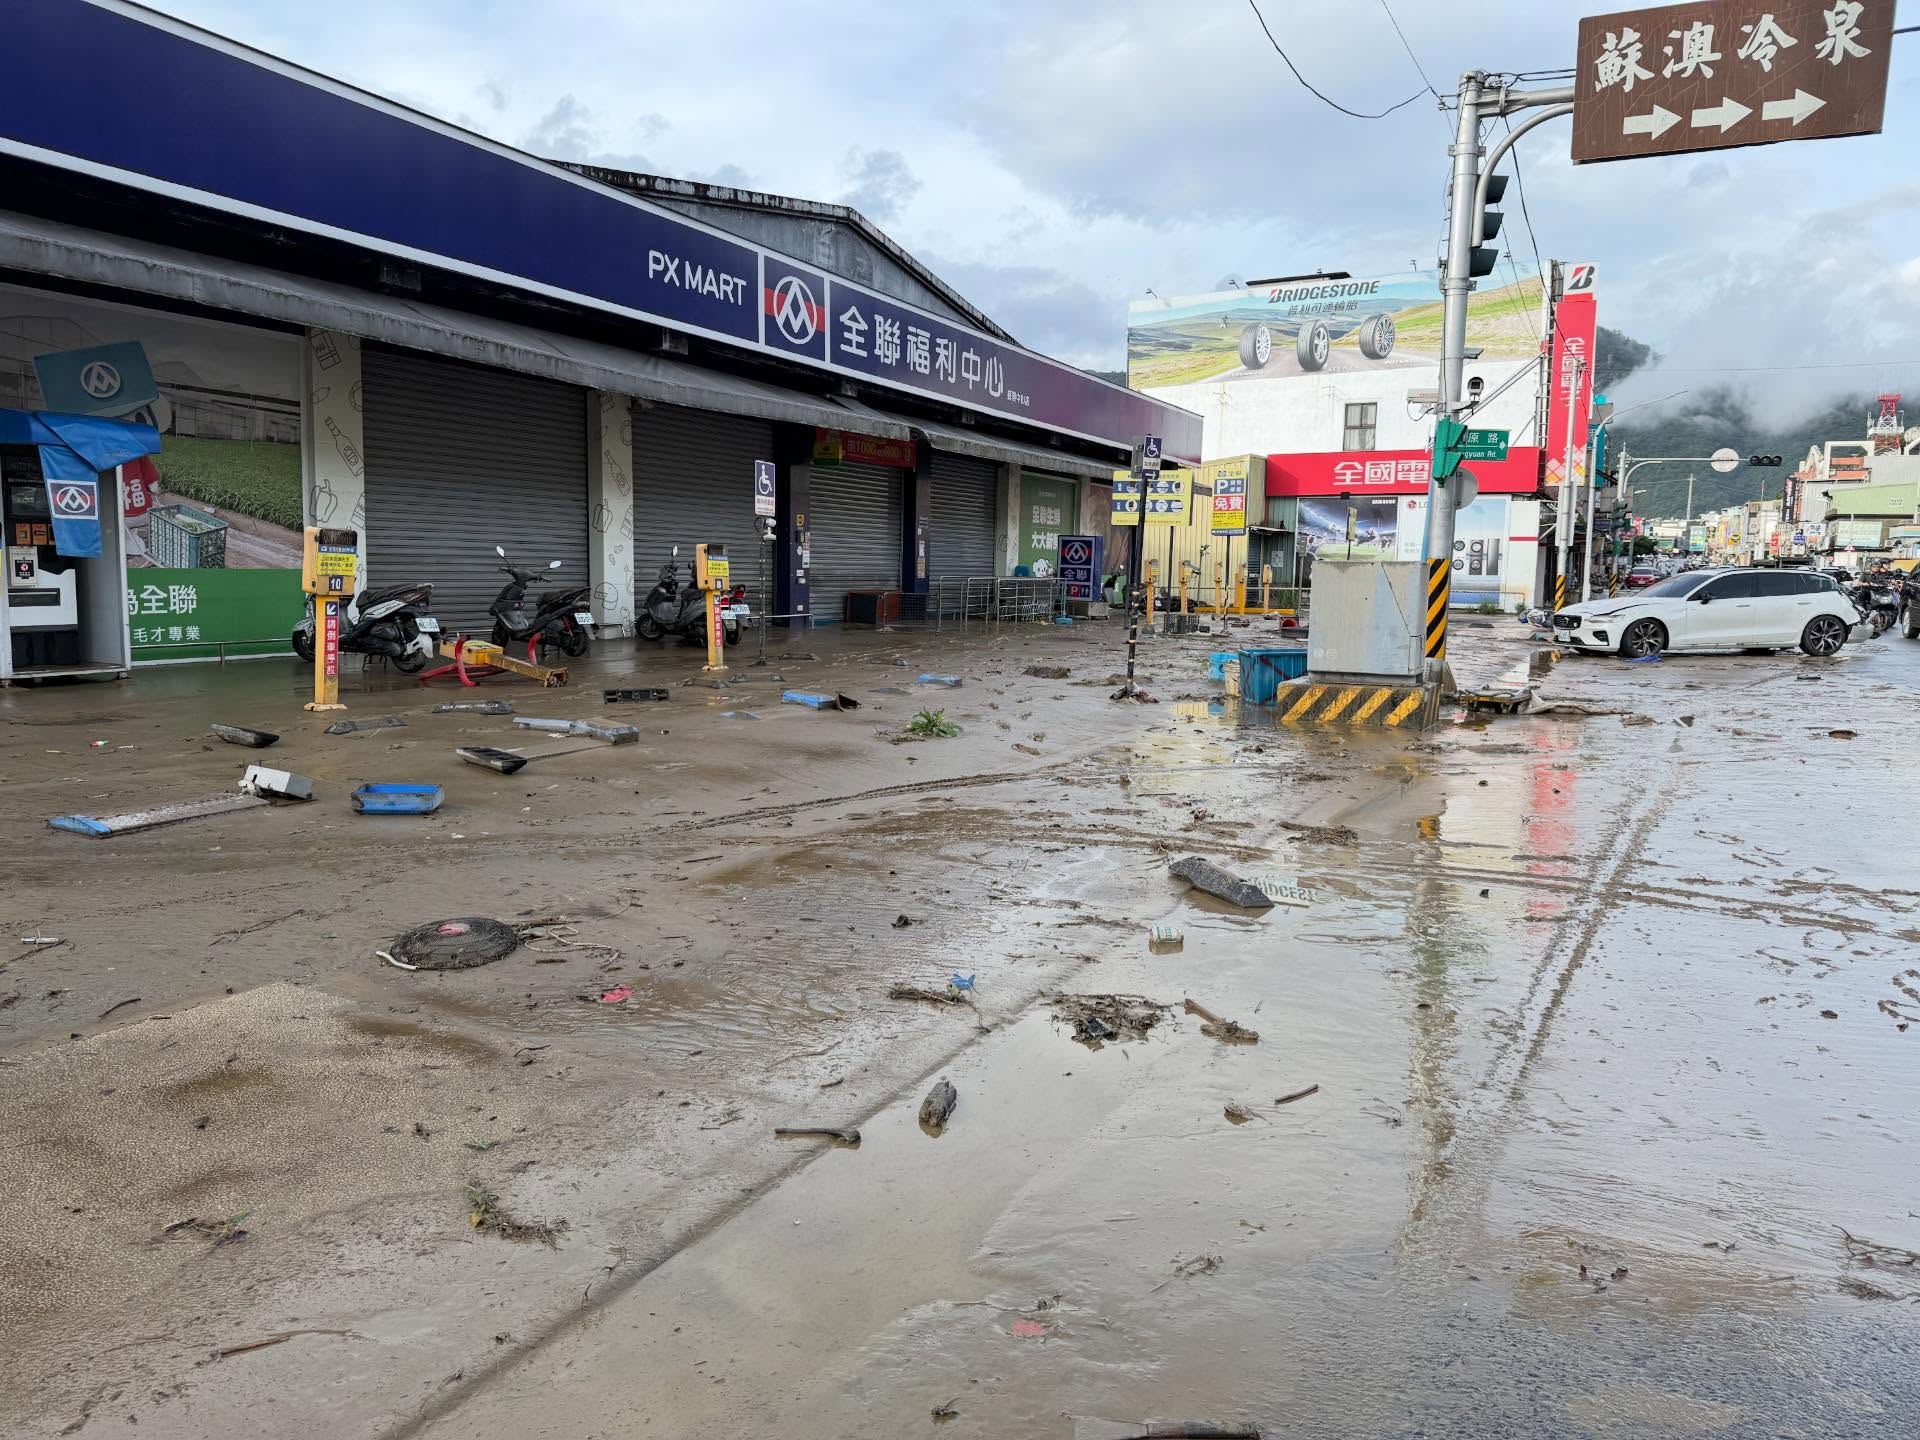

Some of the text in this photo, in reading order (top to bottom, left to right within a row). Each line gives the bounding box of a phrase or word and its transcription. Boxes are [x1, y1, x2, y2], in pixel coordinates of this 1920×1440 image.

[1593, 0, 1872, 93] 蘇澳冷泉
[648, 249, 747, 306] PX MART
[1268, 280, 1381, 304] BRIDGESTONE
[839, 305, 1004, 398] 全聯福利中心
[1465, 431, 1499, 444] 原路
[1216, 480, 1229, 494] P
[1215, 496, 1243, 511] 免費
[1064, 569, 1088, 581] 全聯
[330, 578, 341, 590] 10
[1070, 585, 1079, 595] P
